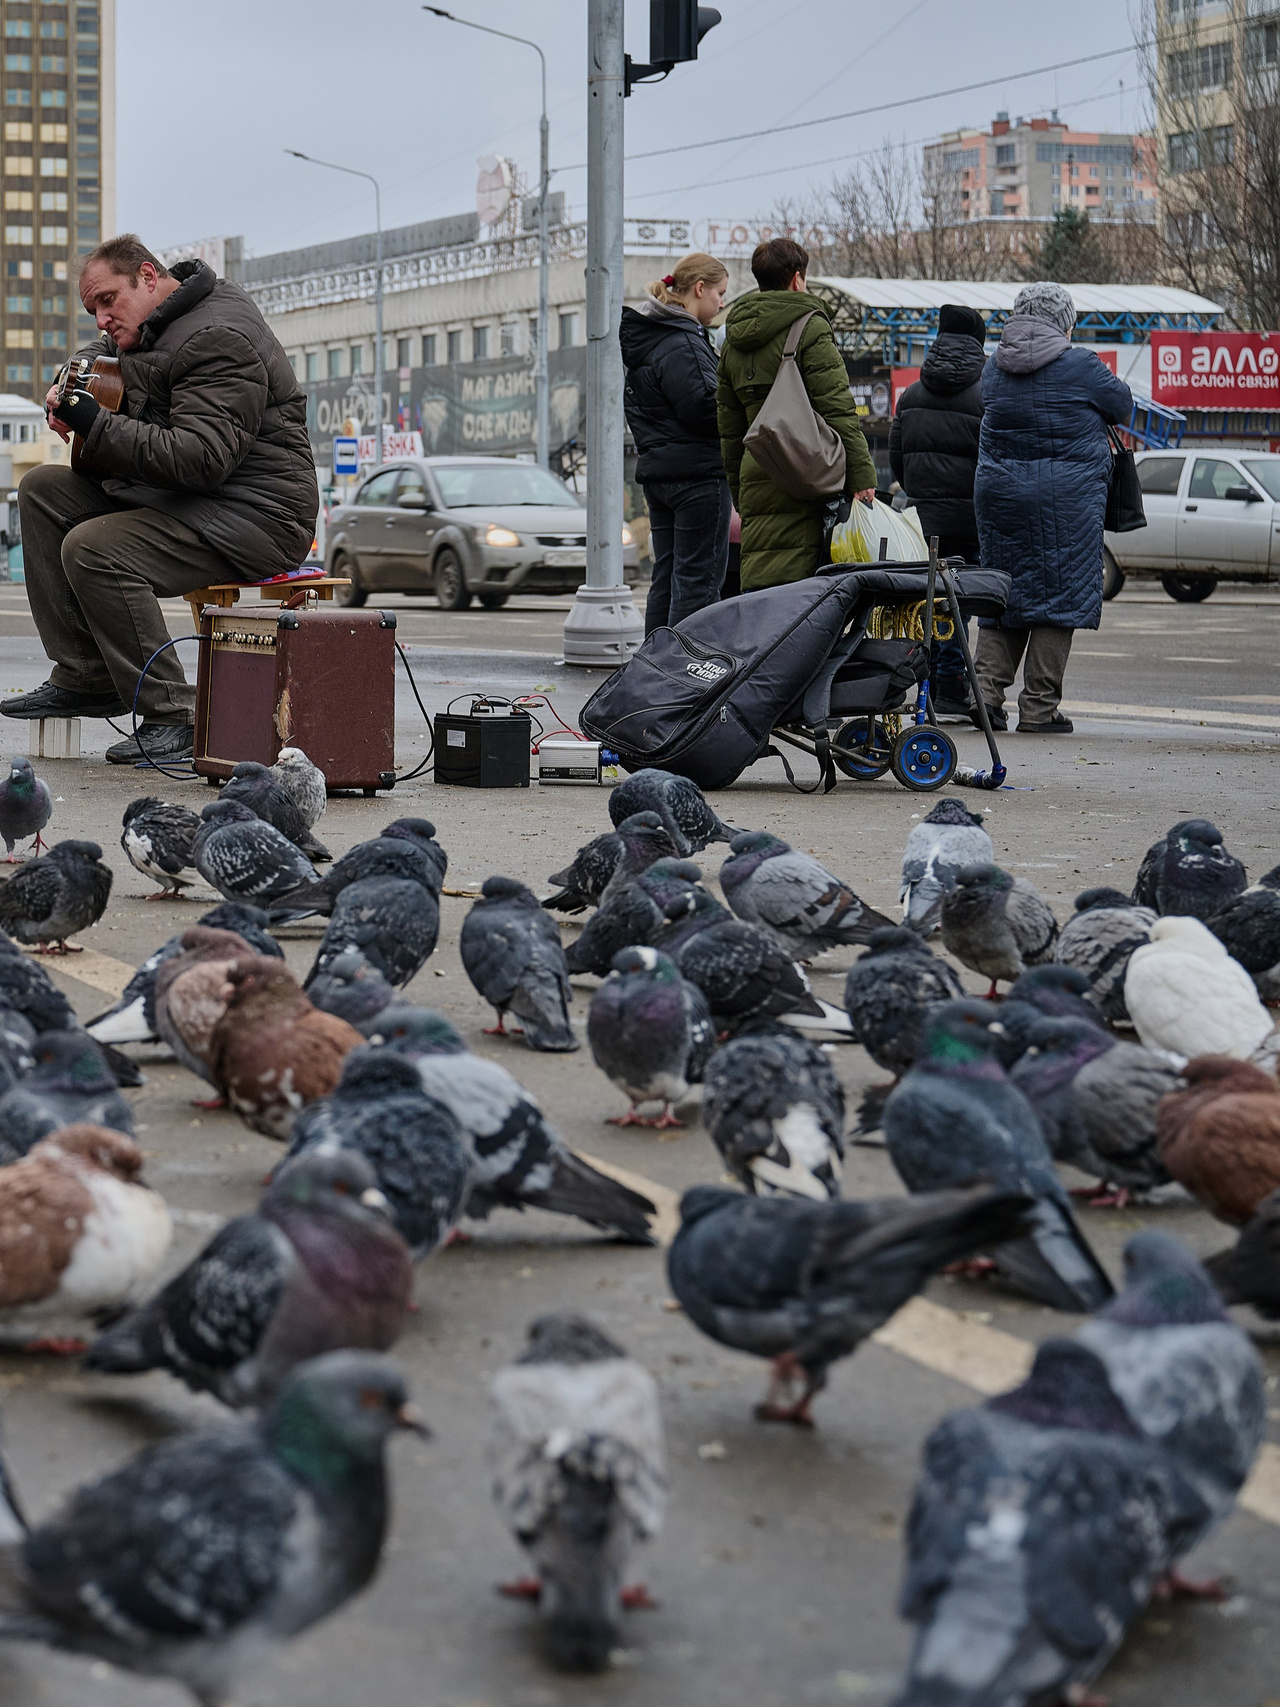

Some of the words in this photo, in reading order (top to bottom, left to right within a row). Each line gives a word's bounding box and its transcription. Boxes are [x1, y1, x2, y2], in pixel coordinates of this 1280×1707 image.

[461, 370, 537, 403] МАГАЗИН
[1158, 372, 1189, 390] plus
[1191, 374, 1235, 388] САЛОН
[1237, 375, 1279, 389] СВЯЗИ
[462, 410, 532, 442] ОДЕЖДЫ
[357, 435, 417, 459] MATESHKA
